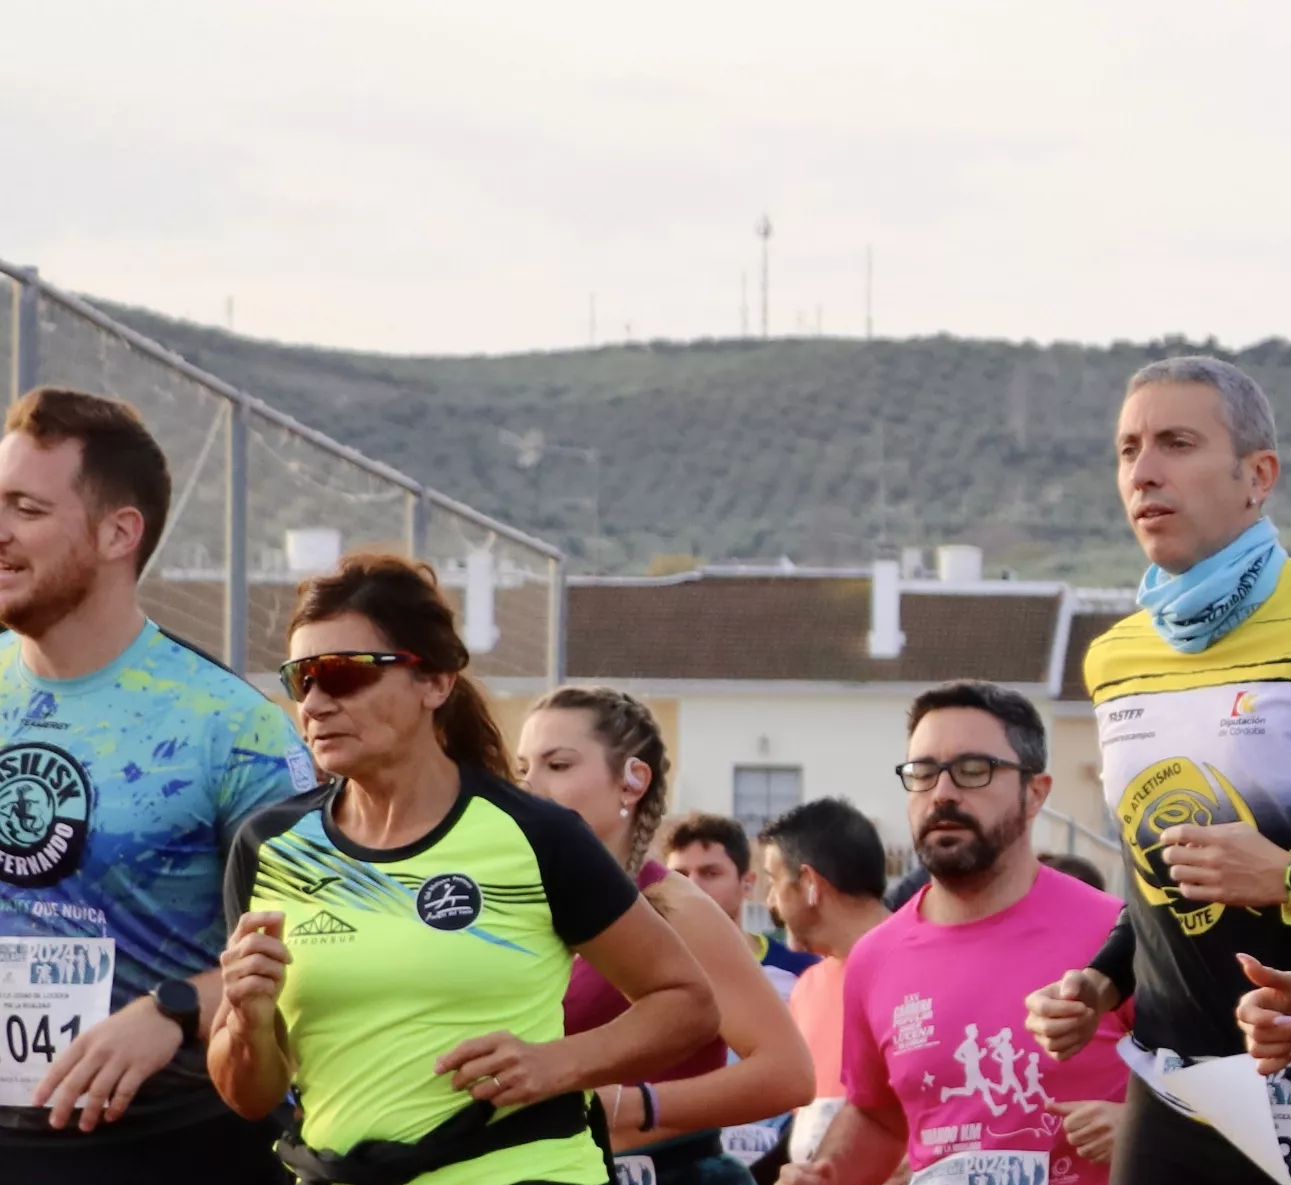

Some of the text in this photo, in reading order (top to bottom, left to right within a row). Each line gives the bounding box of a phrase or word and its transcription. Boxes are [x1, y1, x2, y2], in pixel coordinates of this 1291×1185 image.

[0, 752, 82, 807] SILISK
[1131, 762, 1182, 811] ATLETISMO
[32, 901, 60, 917] QUE
[967, 1155, 1012, 1175] 2024
